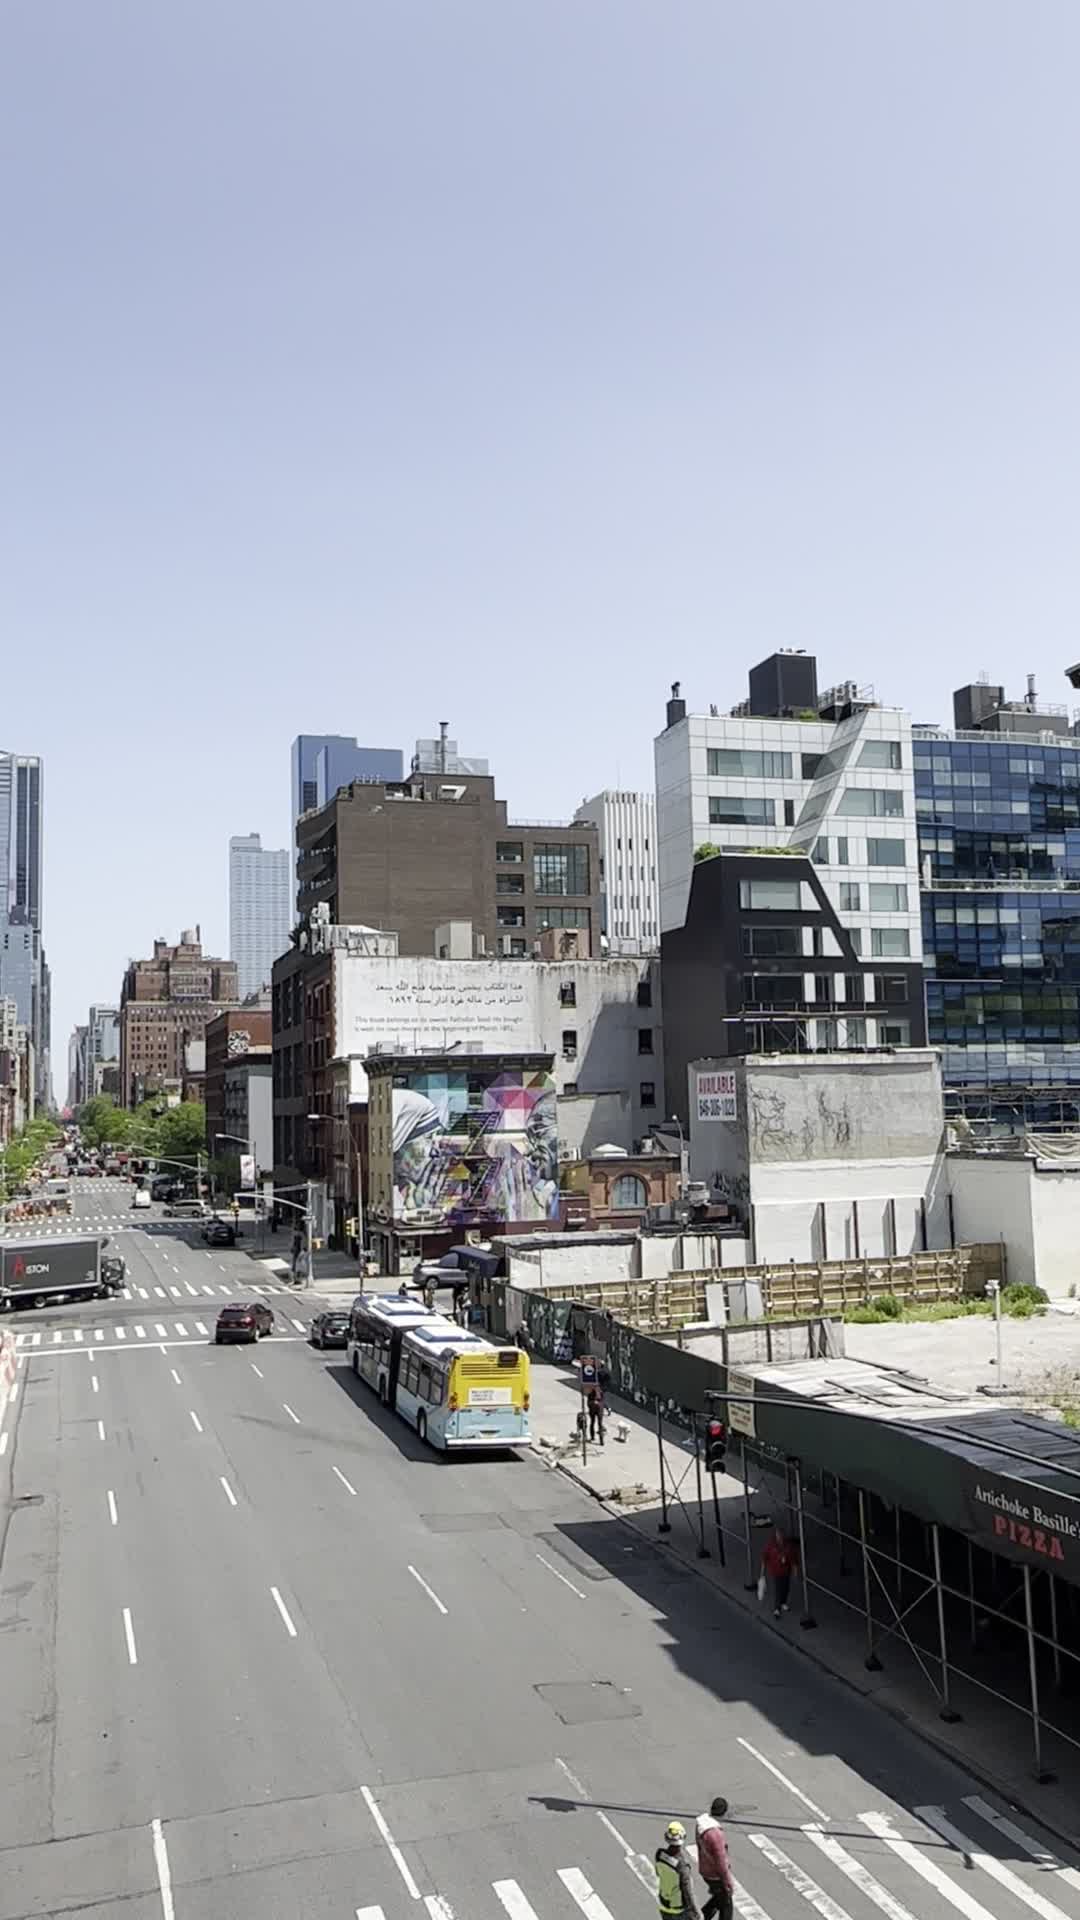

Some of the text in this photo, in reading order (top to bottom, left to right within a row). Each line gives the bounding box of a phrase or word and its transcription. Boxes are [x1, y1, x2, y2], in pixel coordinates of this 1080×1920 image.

[699, 1075, 735, 1094] AVAILABLE
[974, 1484, 1080, 1539] Artichoke Basille'
[992, 1514, 1065, 1561] PIZZA
